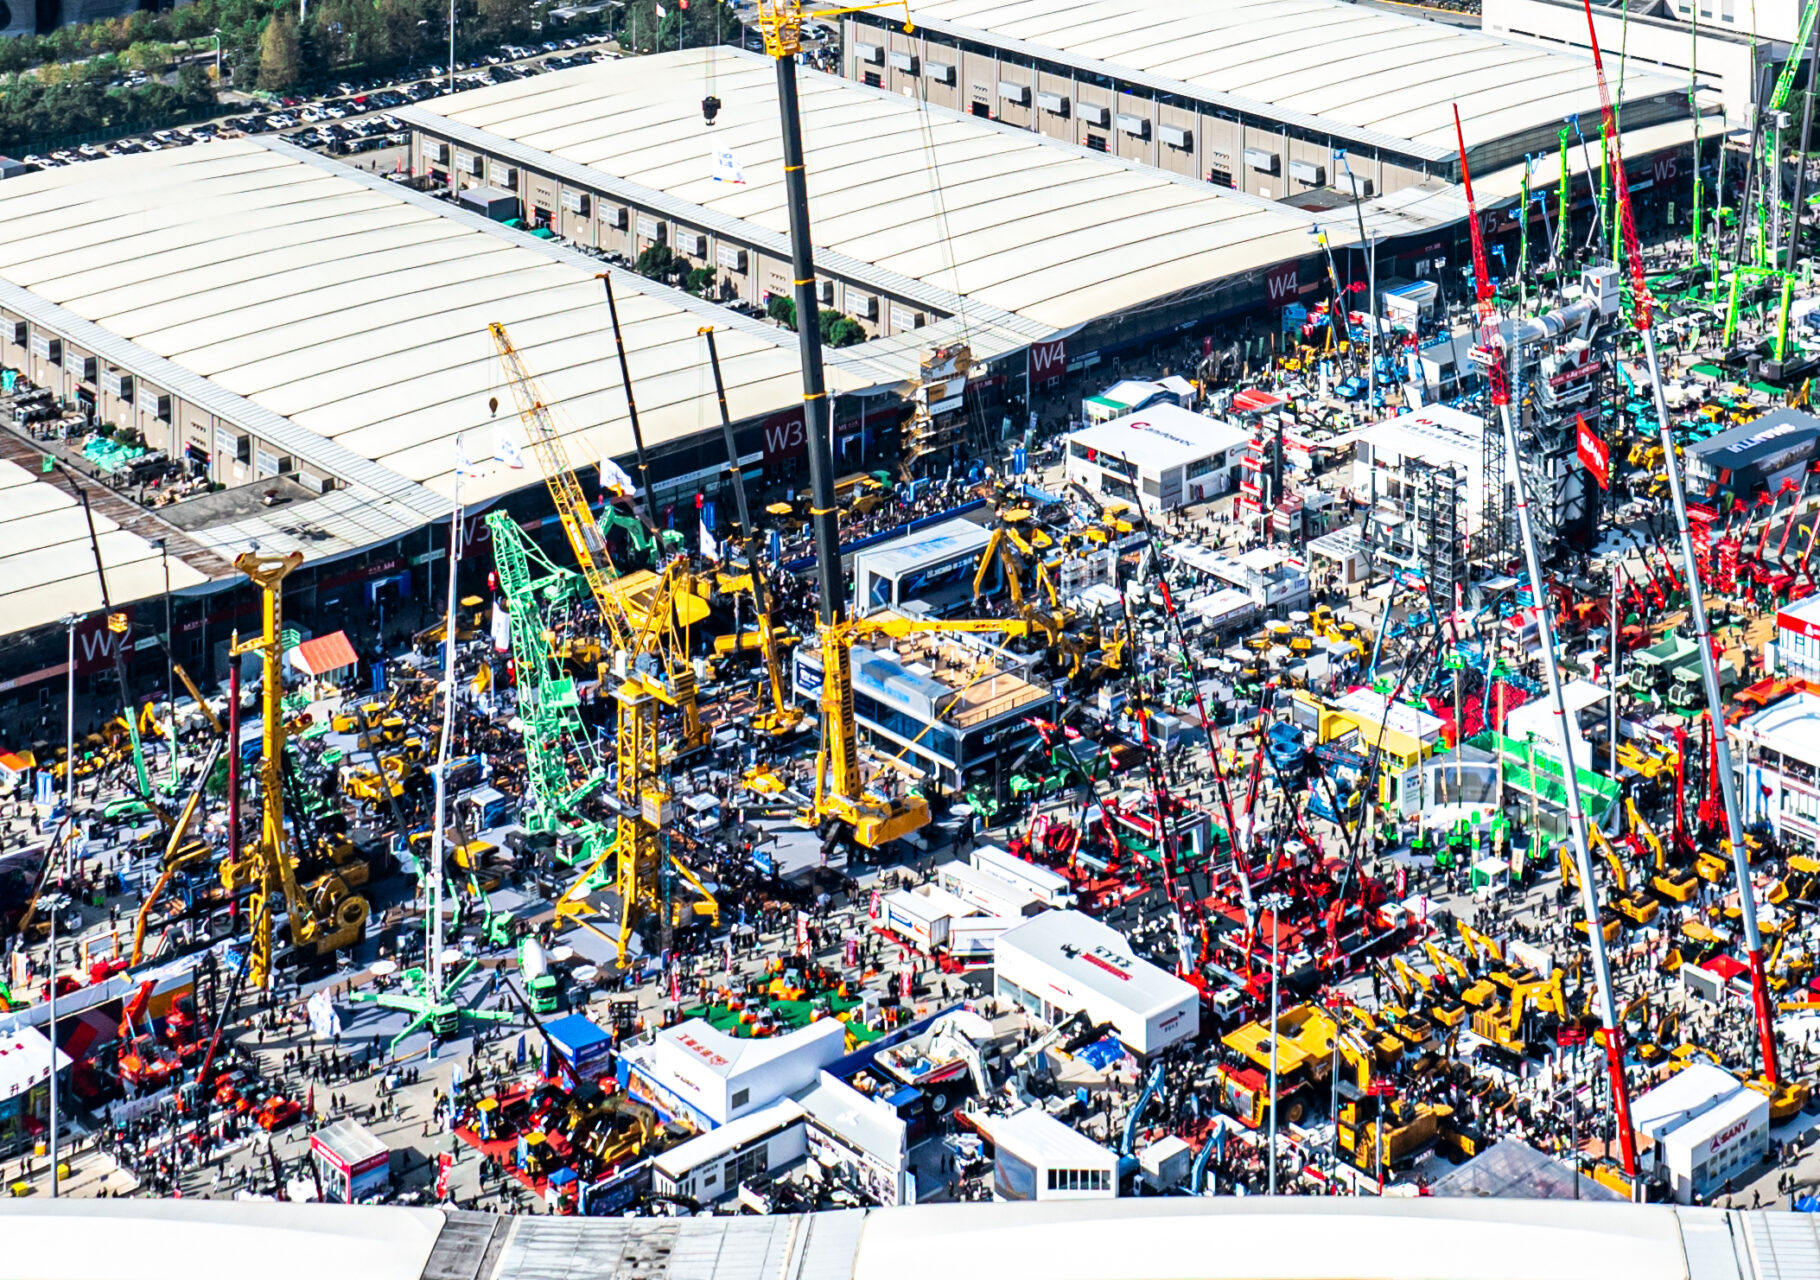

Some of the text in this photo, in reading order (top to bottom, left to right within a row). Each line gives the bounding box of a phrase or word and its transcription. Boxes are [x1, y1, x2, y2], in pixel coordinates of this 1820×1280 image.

[1654, 157, 1677, 182] W5
[1268, 271, 1298, 300] W4
[1032, 341, 1066, 372] W4
[765, 420, 803, 453] W3
[1721, 1119, 1748, 1144] SANY
